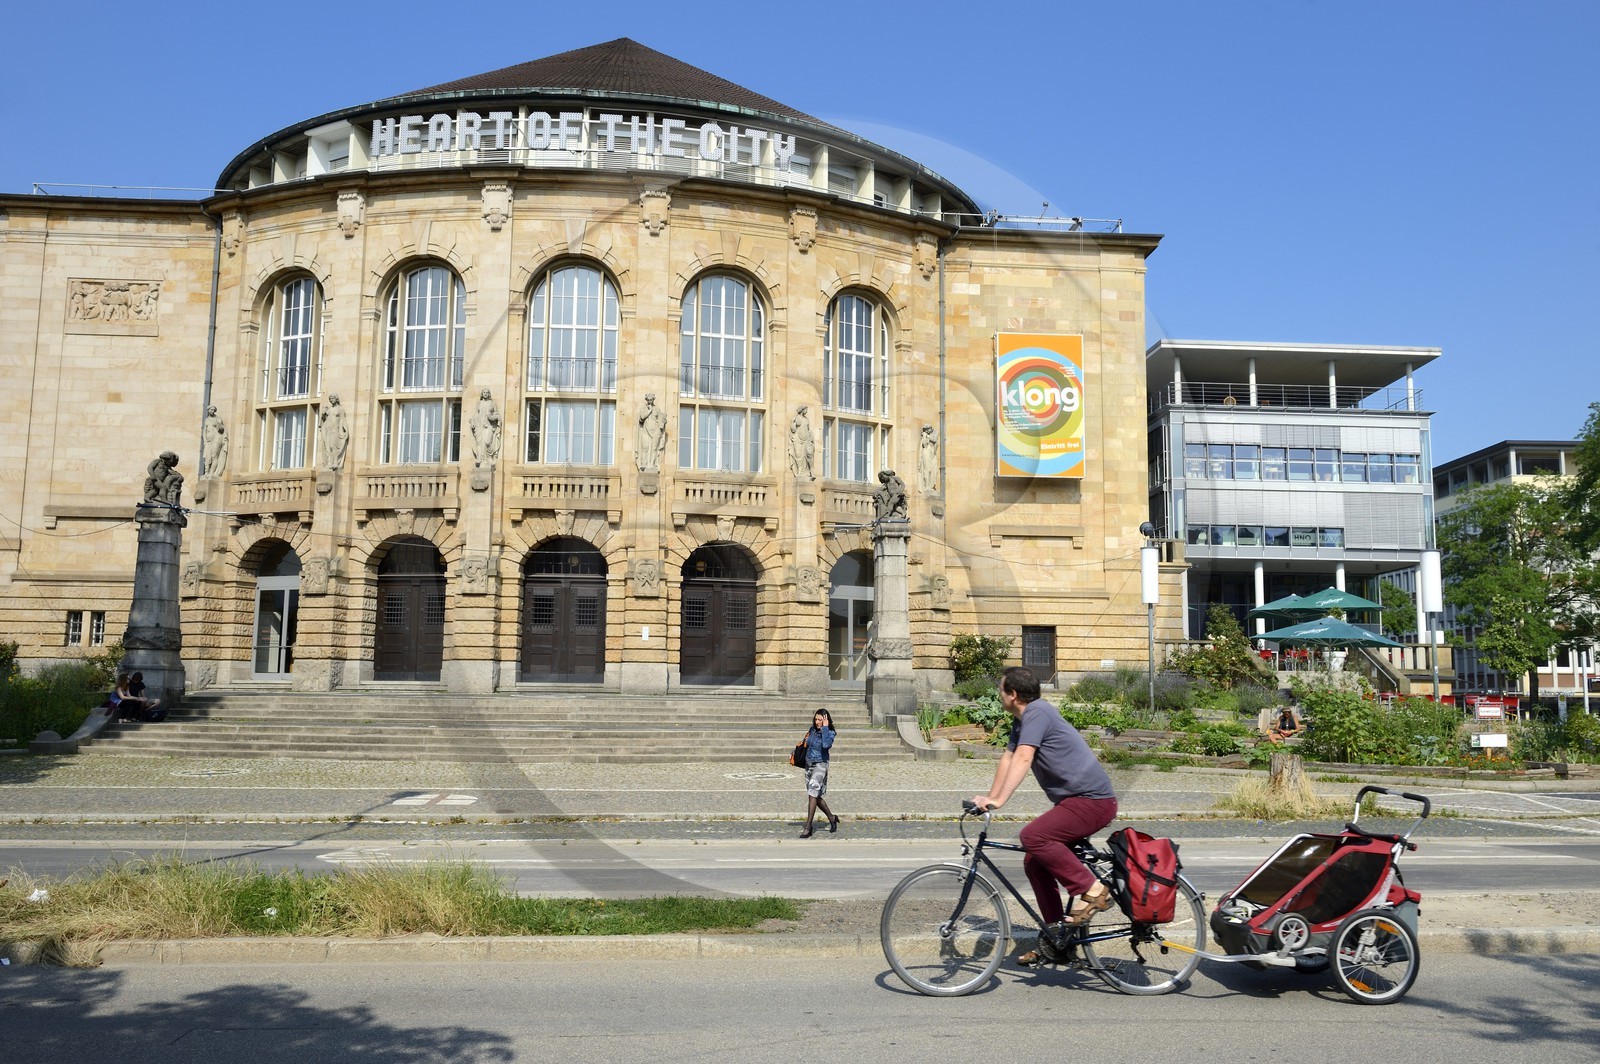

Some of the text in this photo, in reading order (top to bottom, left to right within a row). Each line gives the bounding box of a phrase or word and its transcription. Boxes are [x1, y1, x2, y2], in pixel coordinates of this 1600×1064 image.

[371, 111, 796, 170] HEART OF THE CITY
[1000, 380, 1080, 412] klong
[1319, 534, 1343, 542] PRAX
